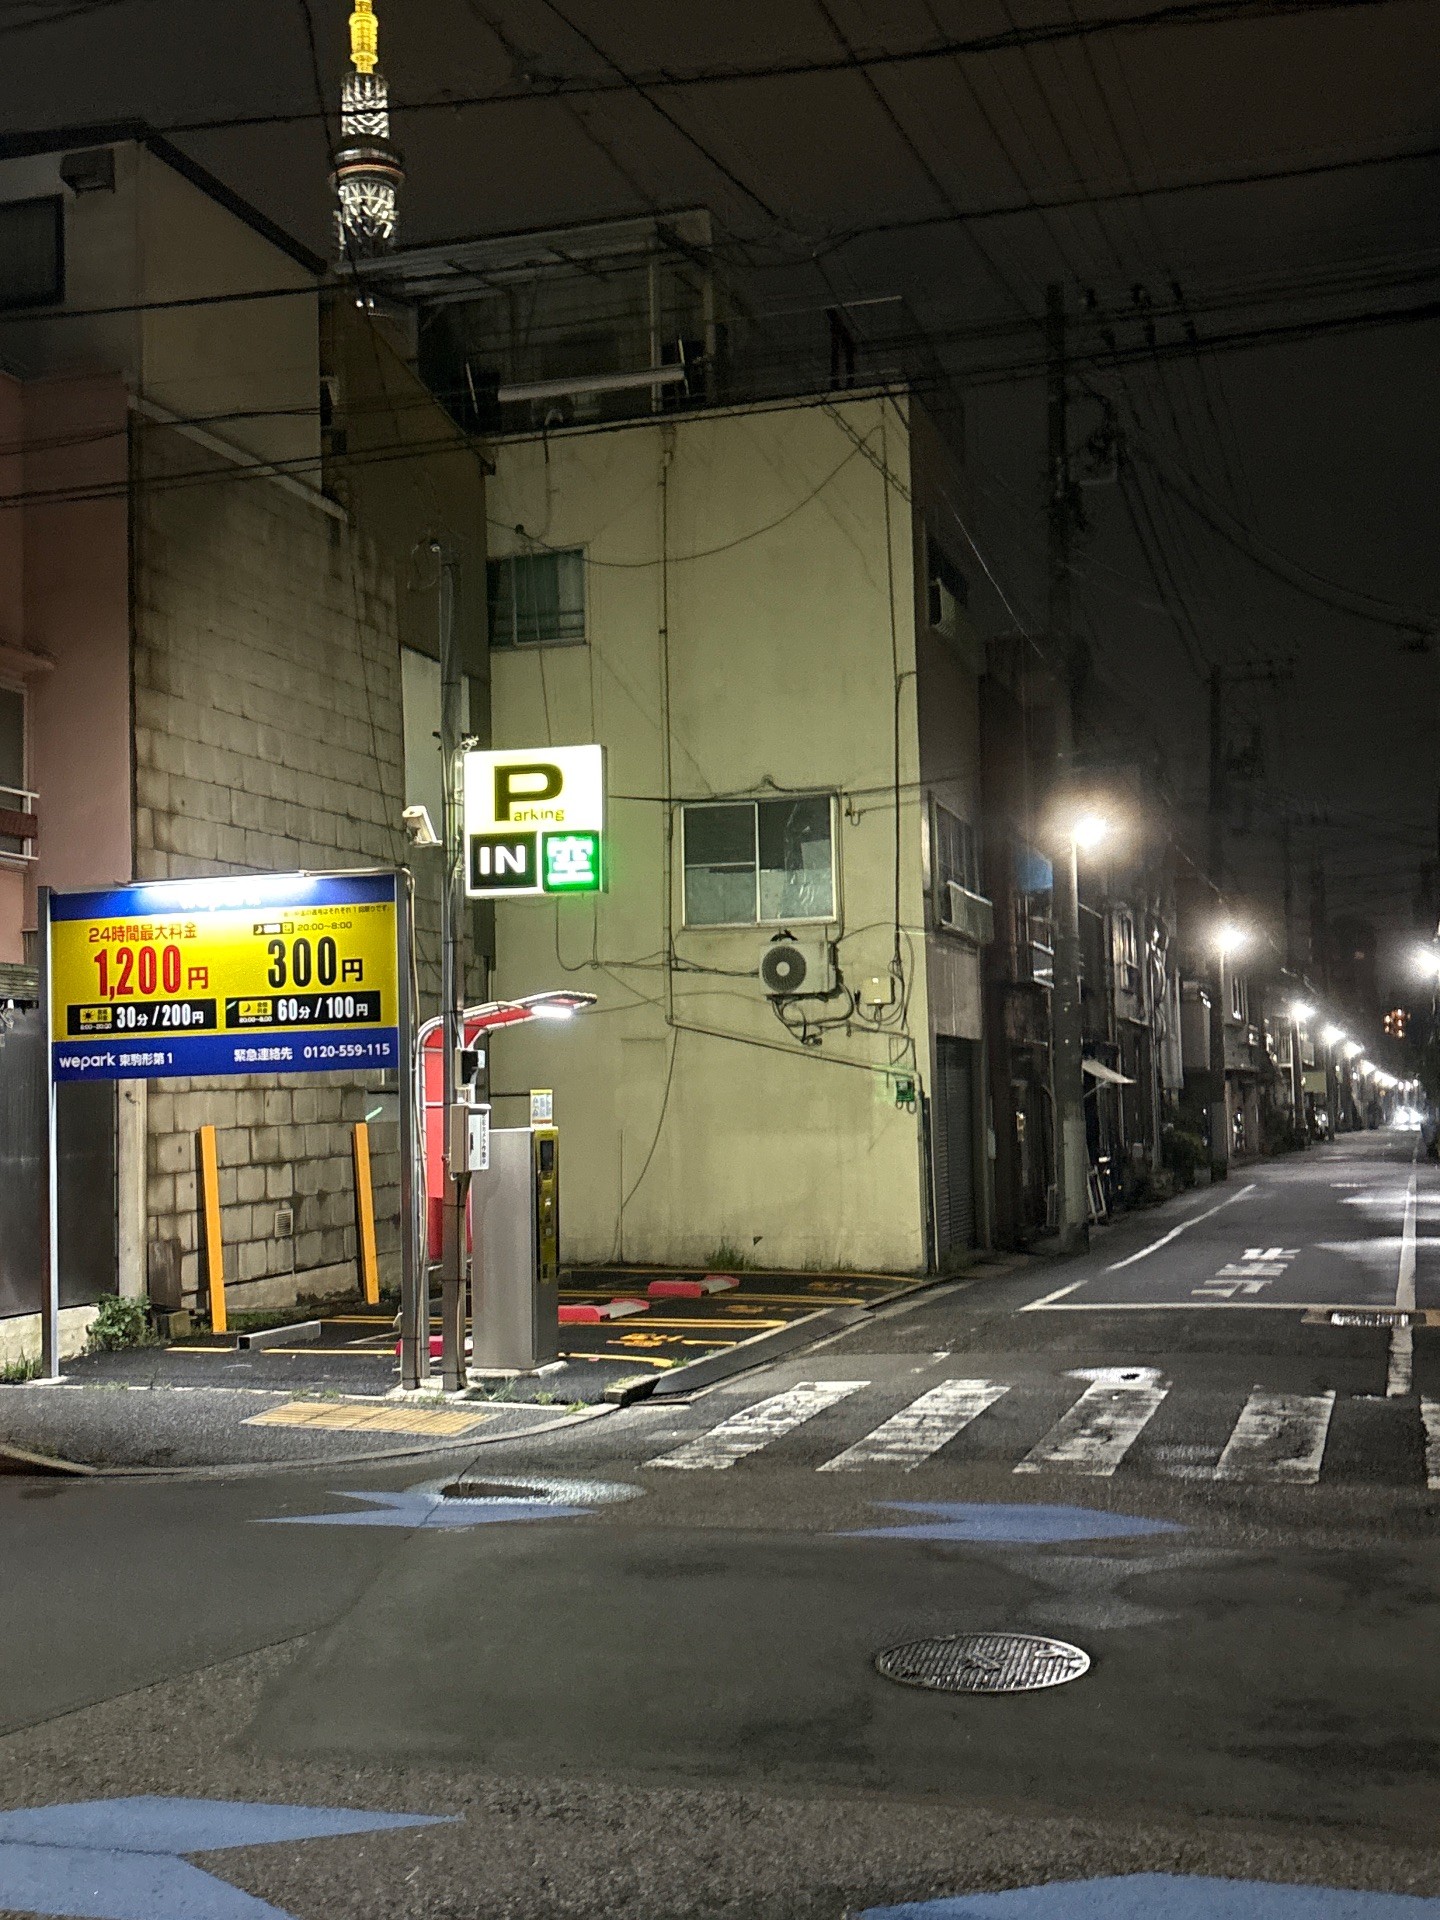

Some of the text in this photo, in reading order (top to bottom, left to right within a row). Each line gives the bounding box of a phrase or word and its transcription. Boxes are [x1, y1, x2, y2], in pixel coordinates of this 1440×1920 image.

[479, 844, 526, 876] IN
[547, 835, 594, 886] 空
[88, 922, 198, 943] 24時間最大料金
[94, 944, 208, 1001] 1,200円
[267, 936, 364, 989] 300円
[59, 1052, 116, 1070] wepark
[233, 1043, 391, 1063] 緊急連絡先 0120-559-115
